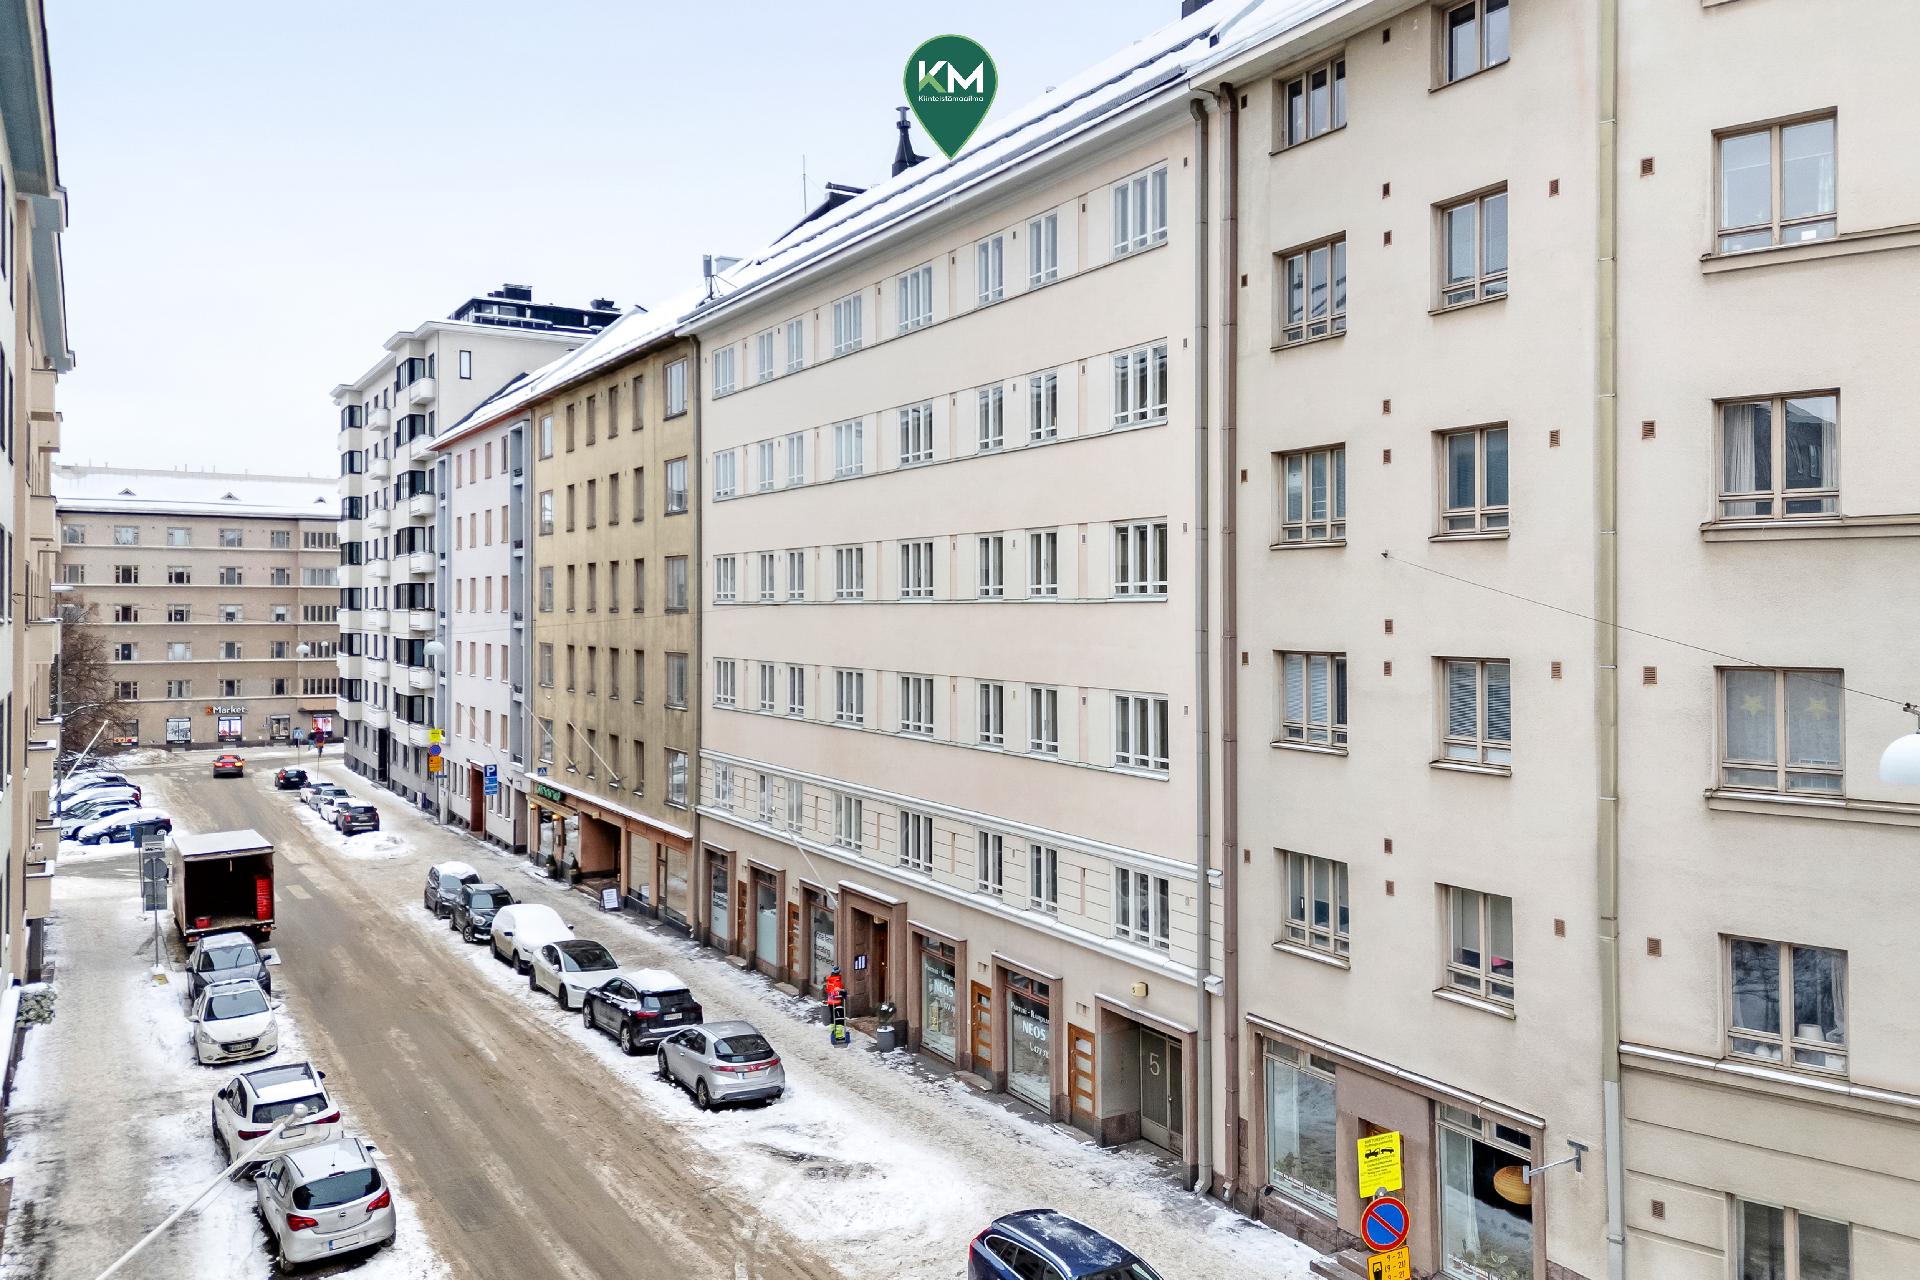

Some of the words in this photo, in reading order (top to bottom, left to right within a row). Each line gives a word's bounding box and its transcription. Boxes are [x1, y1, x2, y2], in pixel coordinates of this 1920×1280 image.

[213, 705, 246, 714] Market
[486, 765, 496, 777] P
[934, 978, 954, 998] NEOS
[1022, 1020, 1046, 1041] NEOS
[1150, 1052, 1160, 1076] 5
